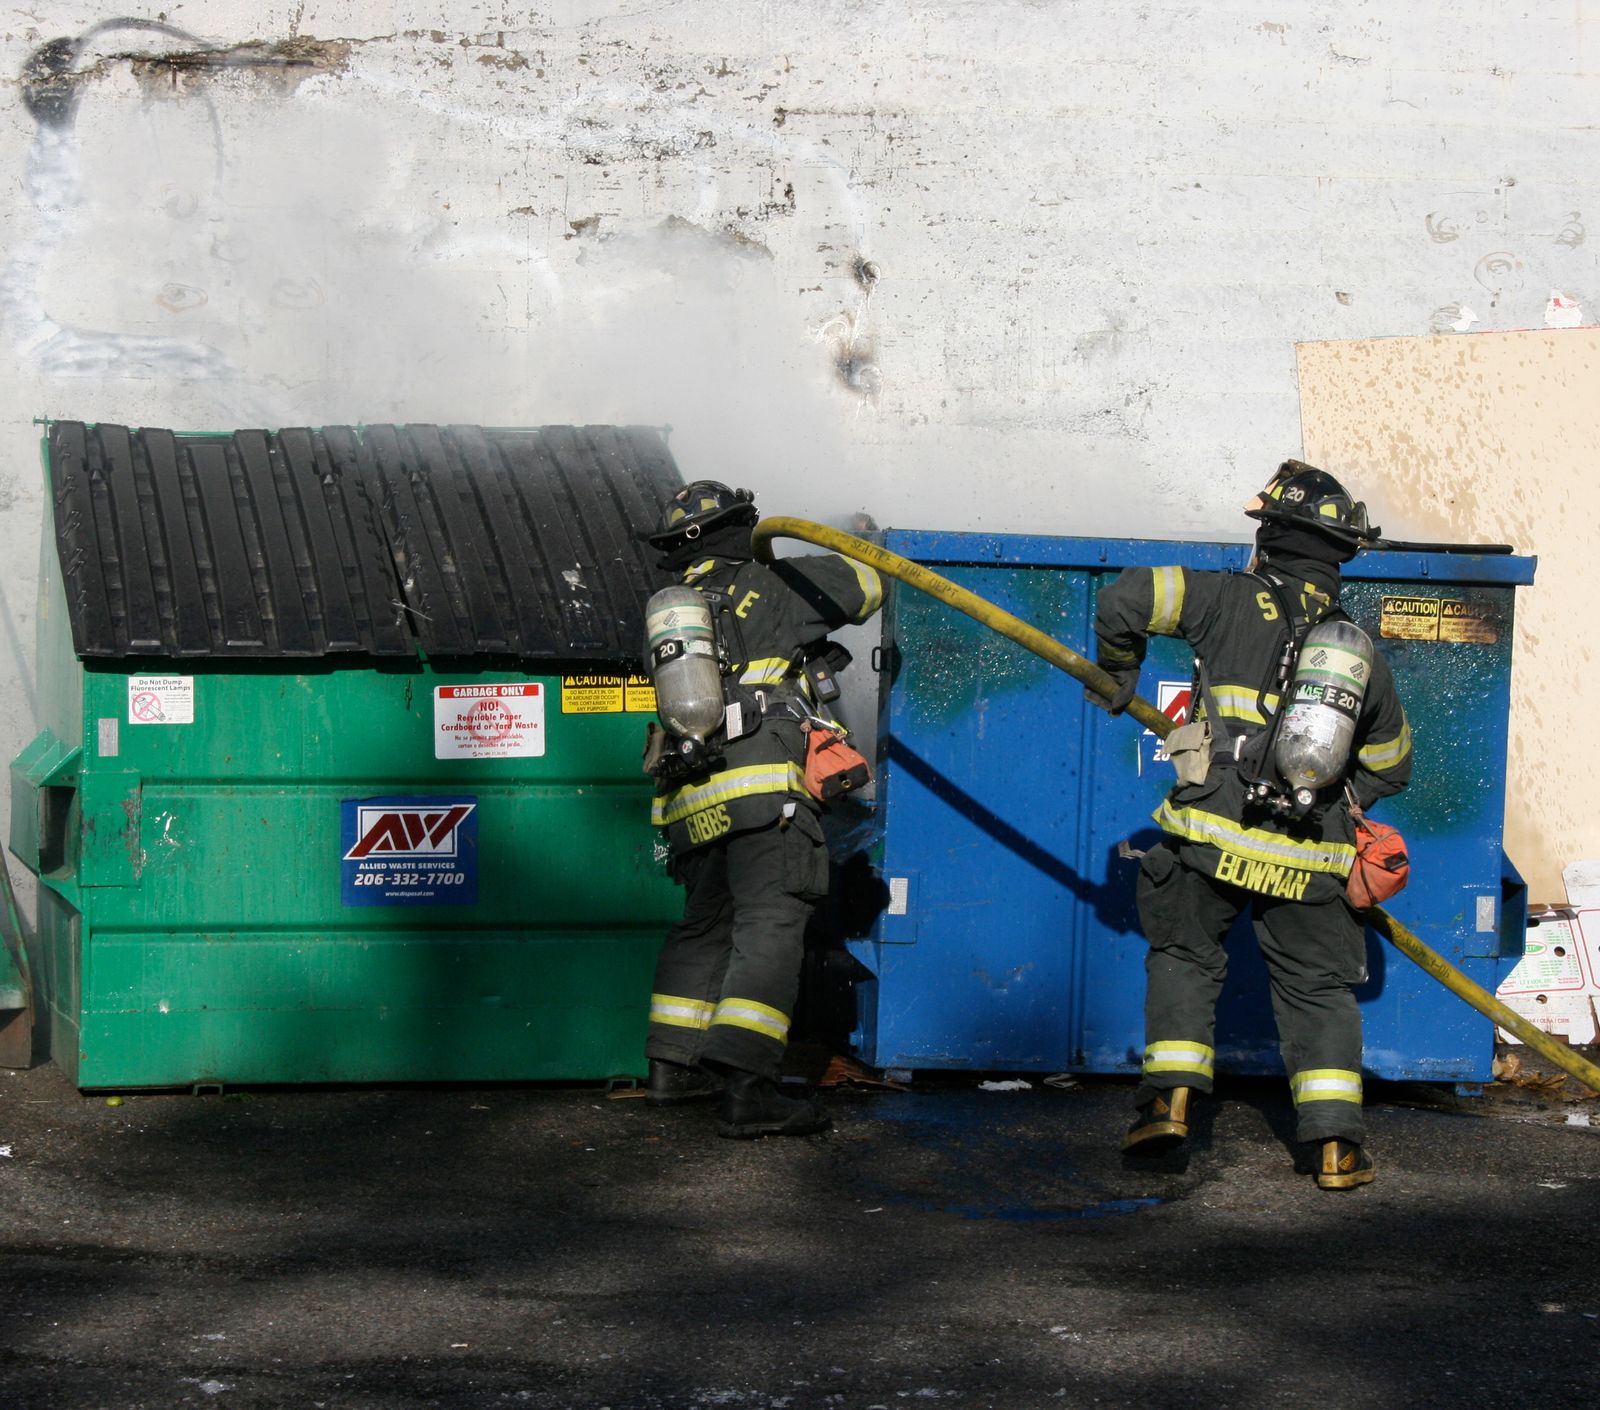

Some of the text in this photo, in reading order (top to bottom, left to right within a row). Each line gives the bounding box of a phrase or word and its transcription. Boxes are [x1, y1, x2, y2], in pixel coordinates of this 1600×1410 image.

[1285, 486, 1305, 502] 20
[1394, 601, 1437, 615] CAUTION
[660, 642, 676, 658] 20
[453, 686, 525, 698] GARBAGE ONLY
[480, 701, 499, 712] NO!
[1338, 692, 1355, 710] 20
[457, 713, 522, 722] Recyclable Paper
[441, 723, 481, 732] Cardboard
[495, 722, 512, 730] Yard
[685, 803, 732, 844] GIBBS
[358, 862, 455, 870] ALLIED WASTE SERVICES
[353, 872, 465, 886] 206-332-7700
[1215, 850, 1311, 900] BOWMAN
